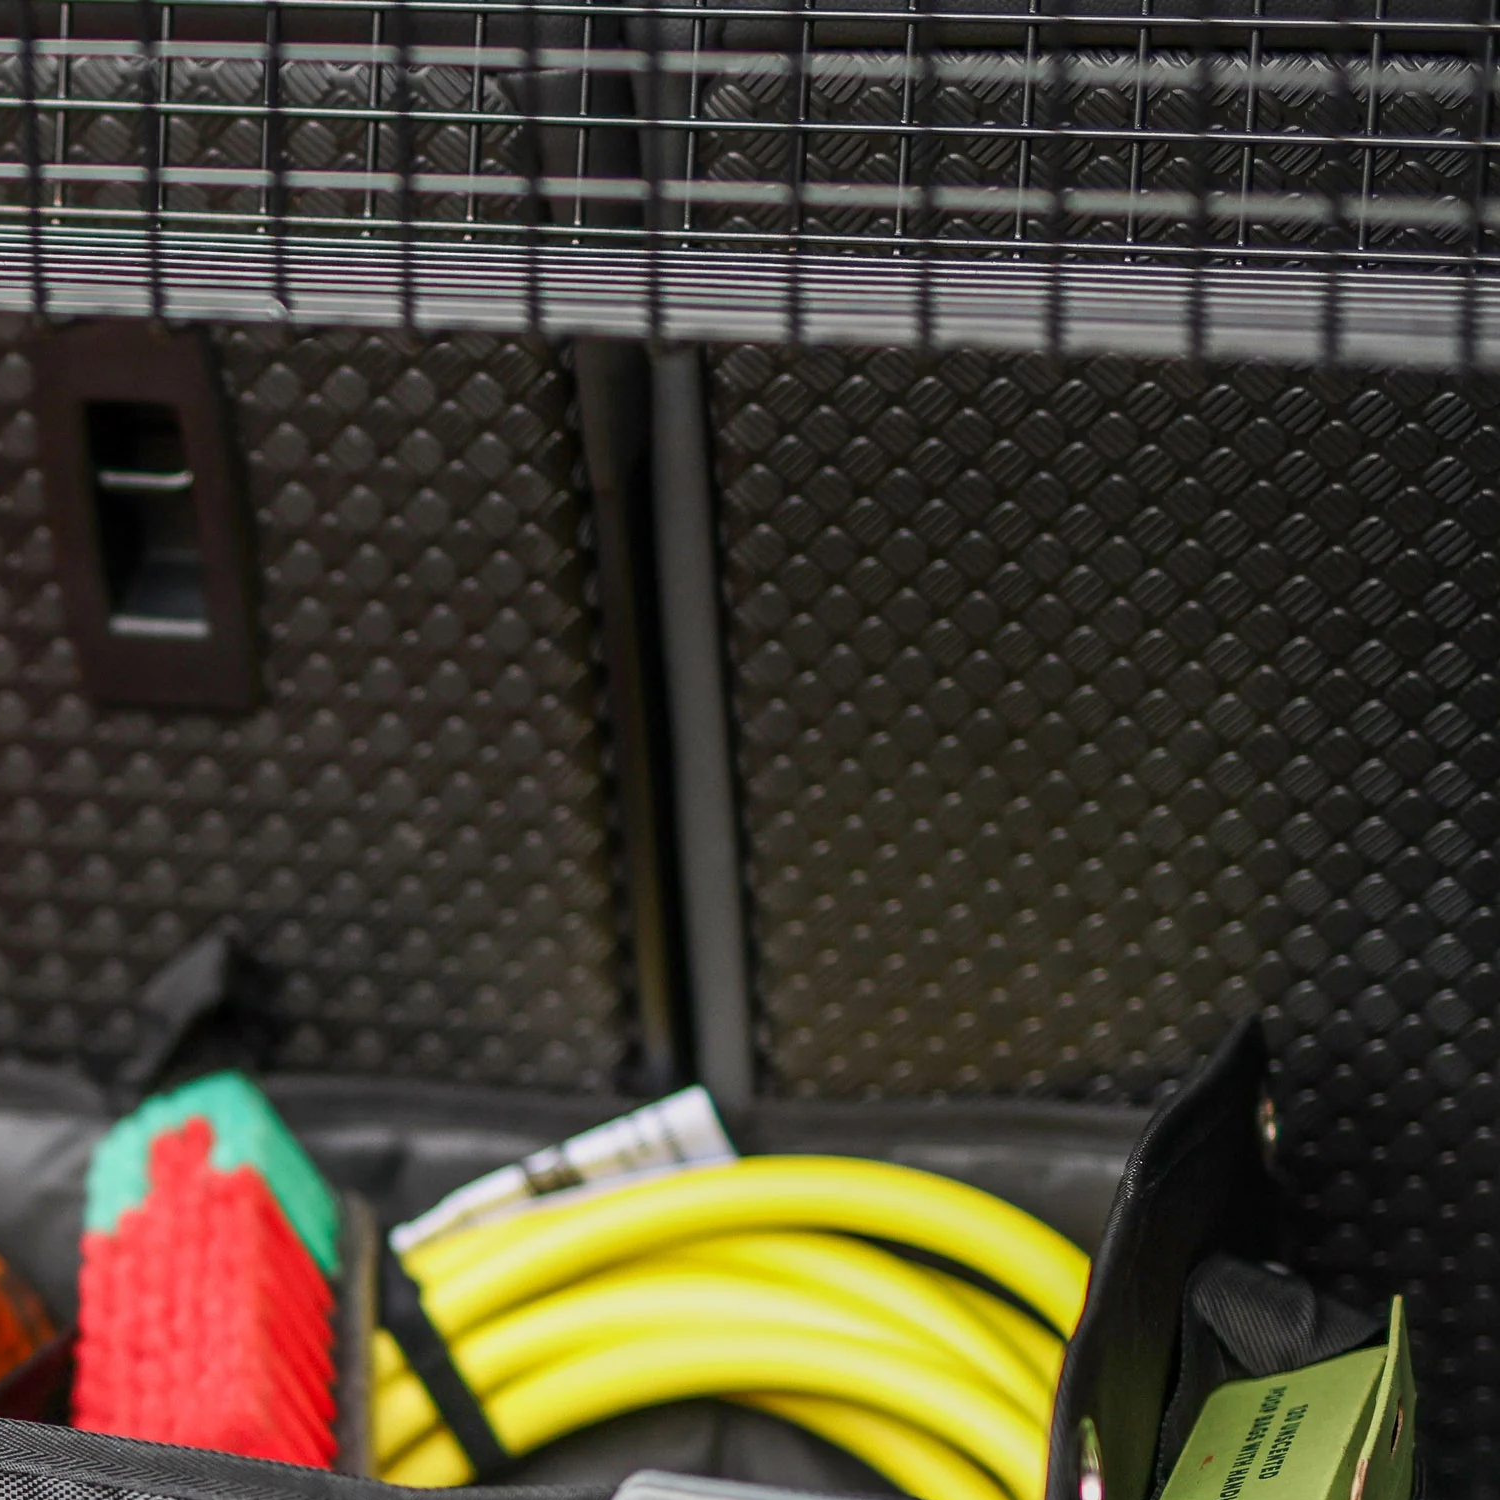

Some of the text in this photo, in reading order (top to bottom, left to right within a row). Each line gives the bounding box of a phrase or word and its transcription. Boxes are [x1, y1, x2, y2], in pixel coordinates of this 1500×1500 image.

[1245, 1414, 1275, 1442] BAGS
[1232, 1440, 1263, 1469] WITH
[1258, 1421, 1302, 1480] UNSCENTED
